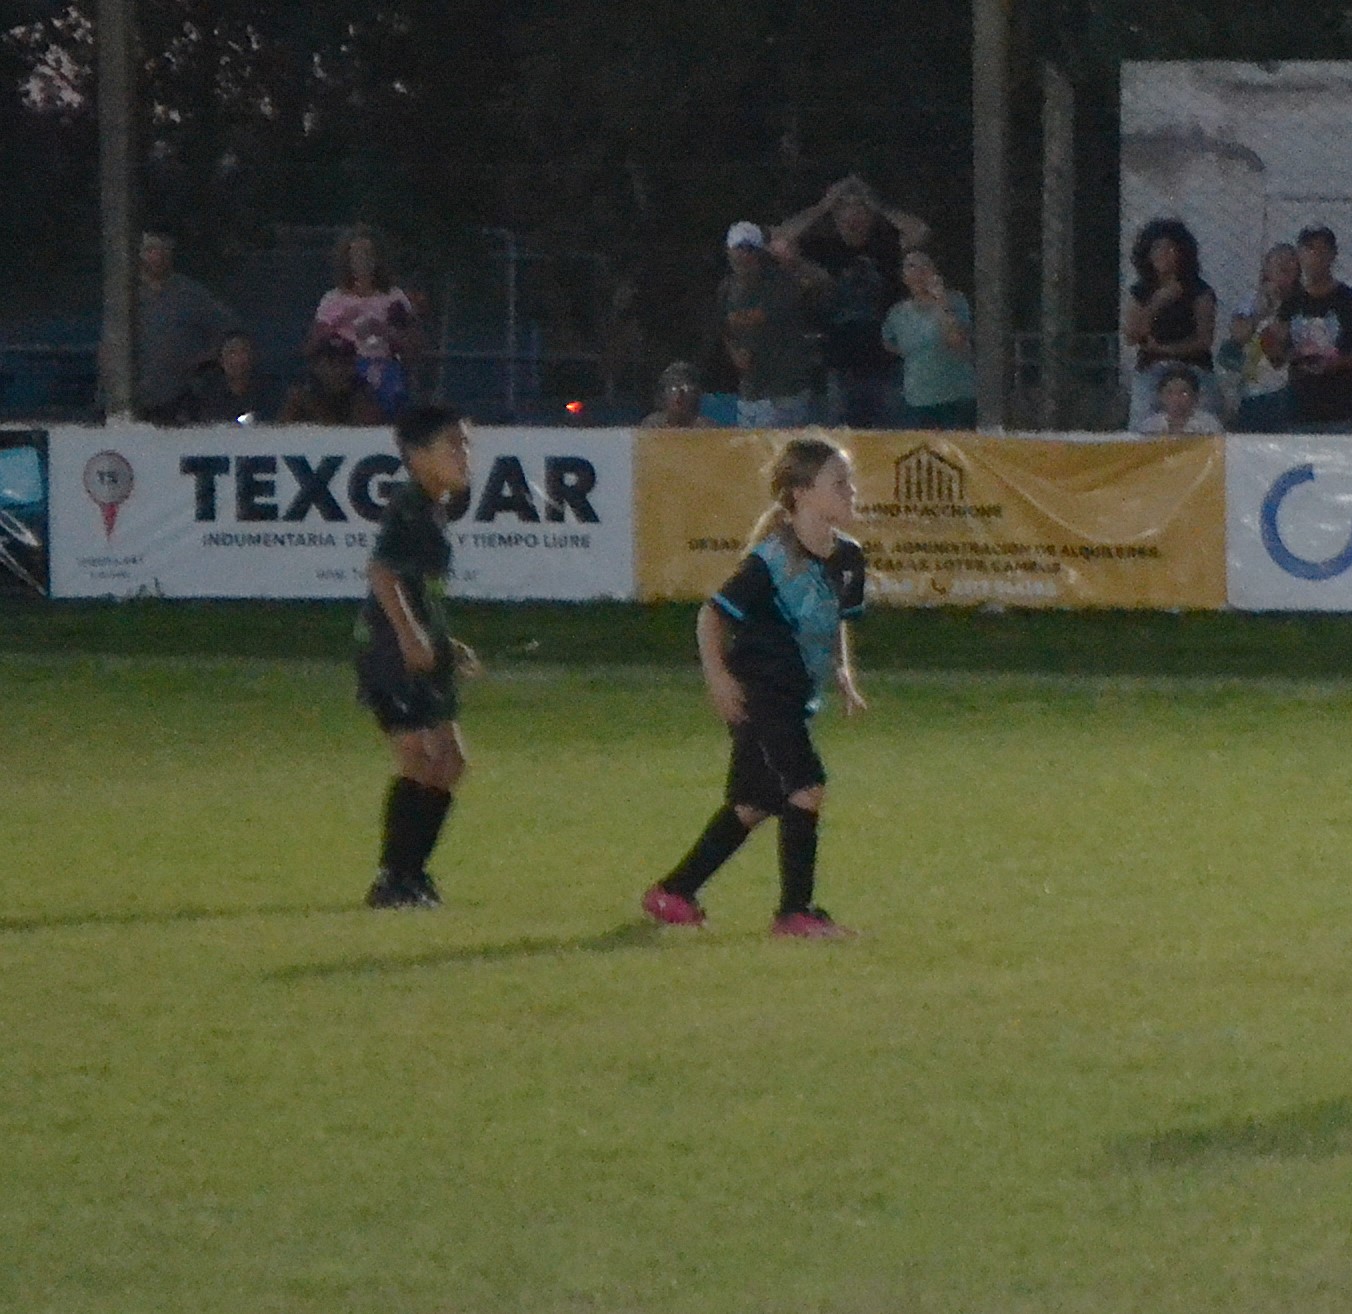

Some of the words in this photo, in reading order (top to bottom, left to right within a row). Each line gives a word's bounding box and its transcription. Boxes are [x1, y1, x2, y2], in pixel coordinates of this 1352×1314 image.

[179, 454, 599, 523] TEXGAR
[203, 533, 335, 547] INDUMENTARIA
[345, 533, 367, 547] DE
[473, 533, 537, 548] TIEMPO
